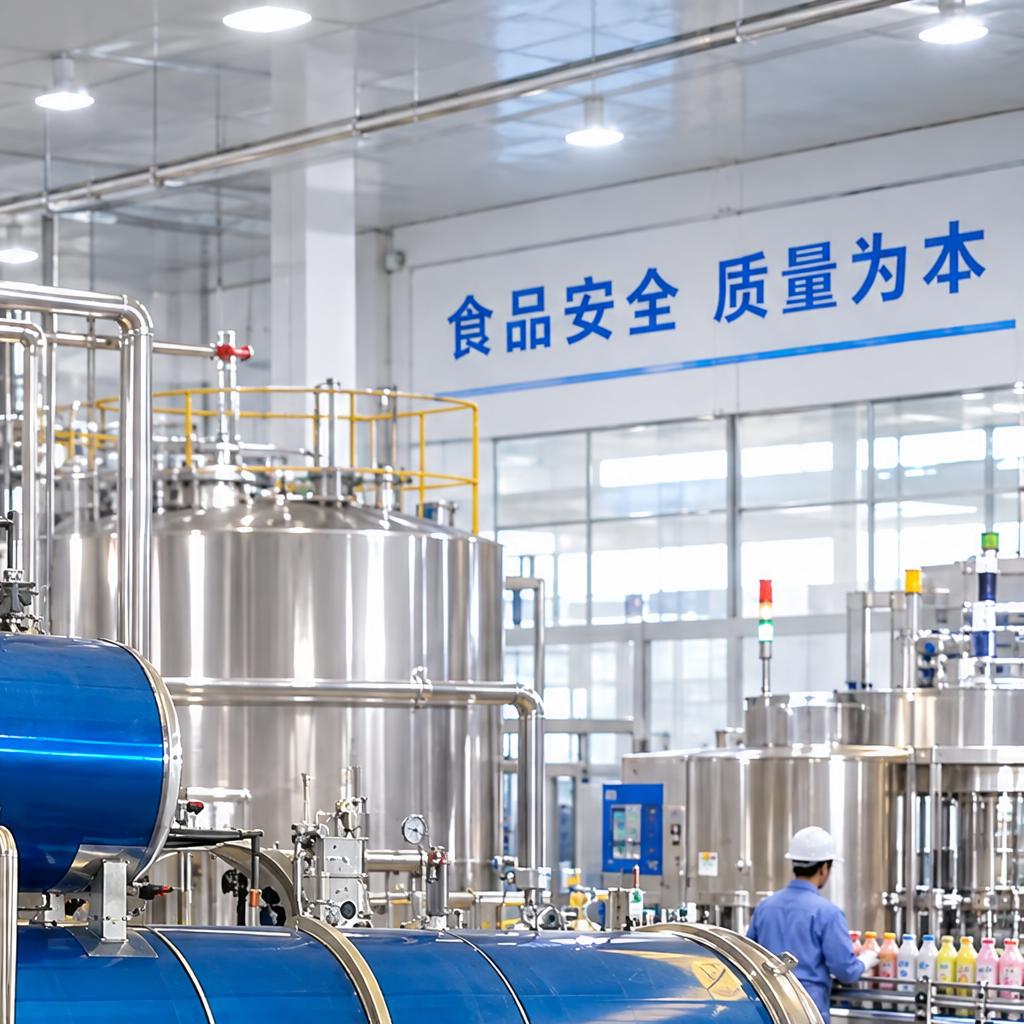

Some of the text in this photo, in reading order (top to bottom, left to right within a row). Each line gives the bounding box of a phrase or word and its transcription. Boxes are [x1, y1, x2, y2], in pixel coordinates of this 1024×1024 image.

[447, 220, 986, 360] 食品安全 质量为本
